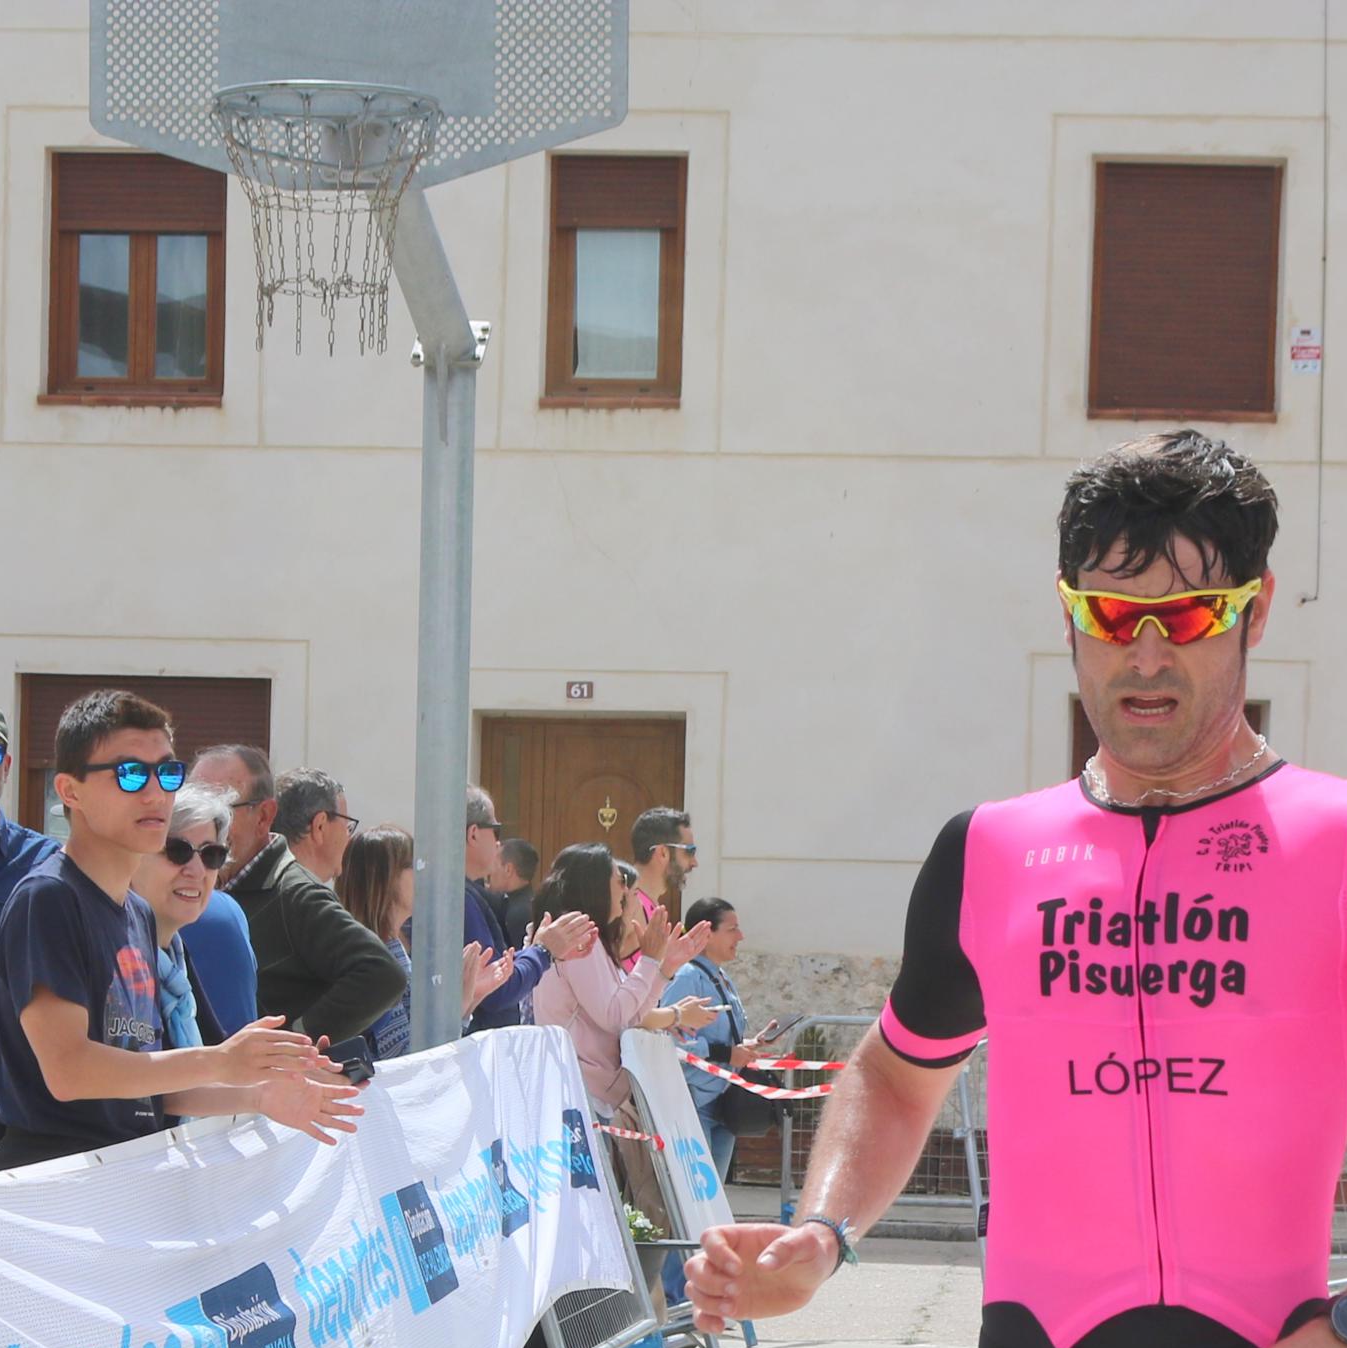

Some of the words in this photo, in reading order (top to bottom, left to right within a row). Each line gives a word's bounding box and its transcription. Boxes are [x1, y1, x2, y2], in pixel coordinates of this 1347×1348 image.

[571, 684, 589, 698] 61
[1024, 843, 1095, 869] GOBIK
[1036, 891, 1250, 948] Triatlón
[1039, 949, 1246, 1009] Pisuerga
[1067, 1051, 1229, 1097] LÓPEZ
